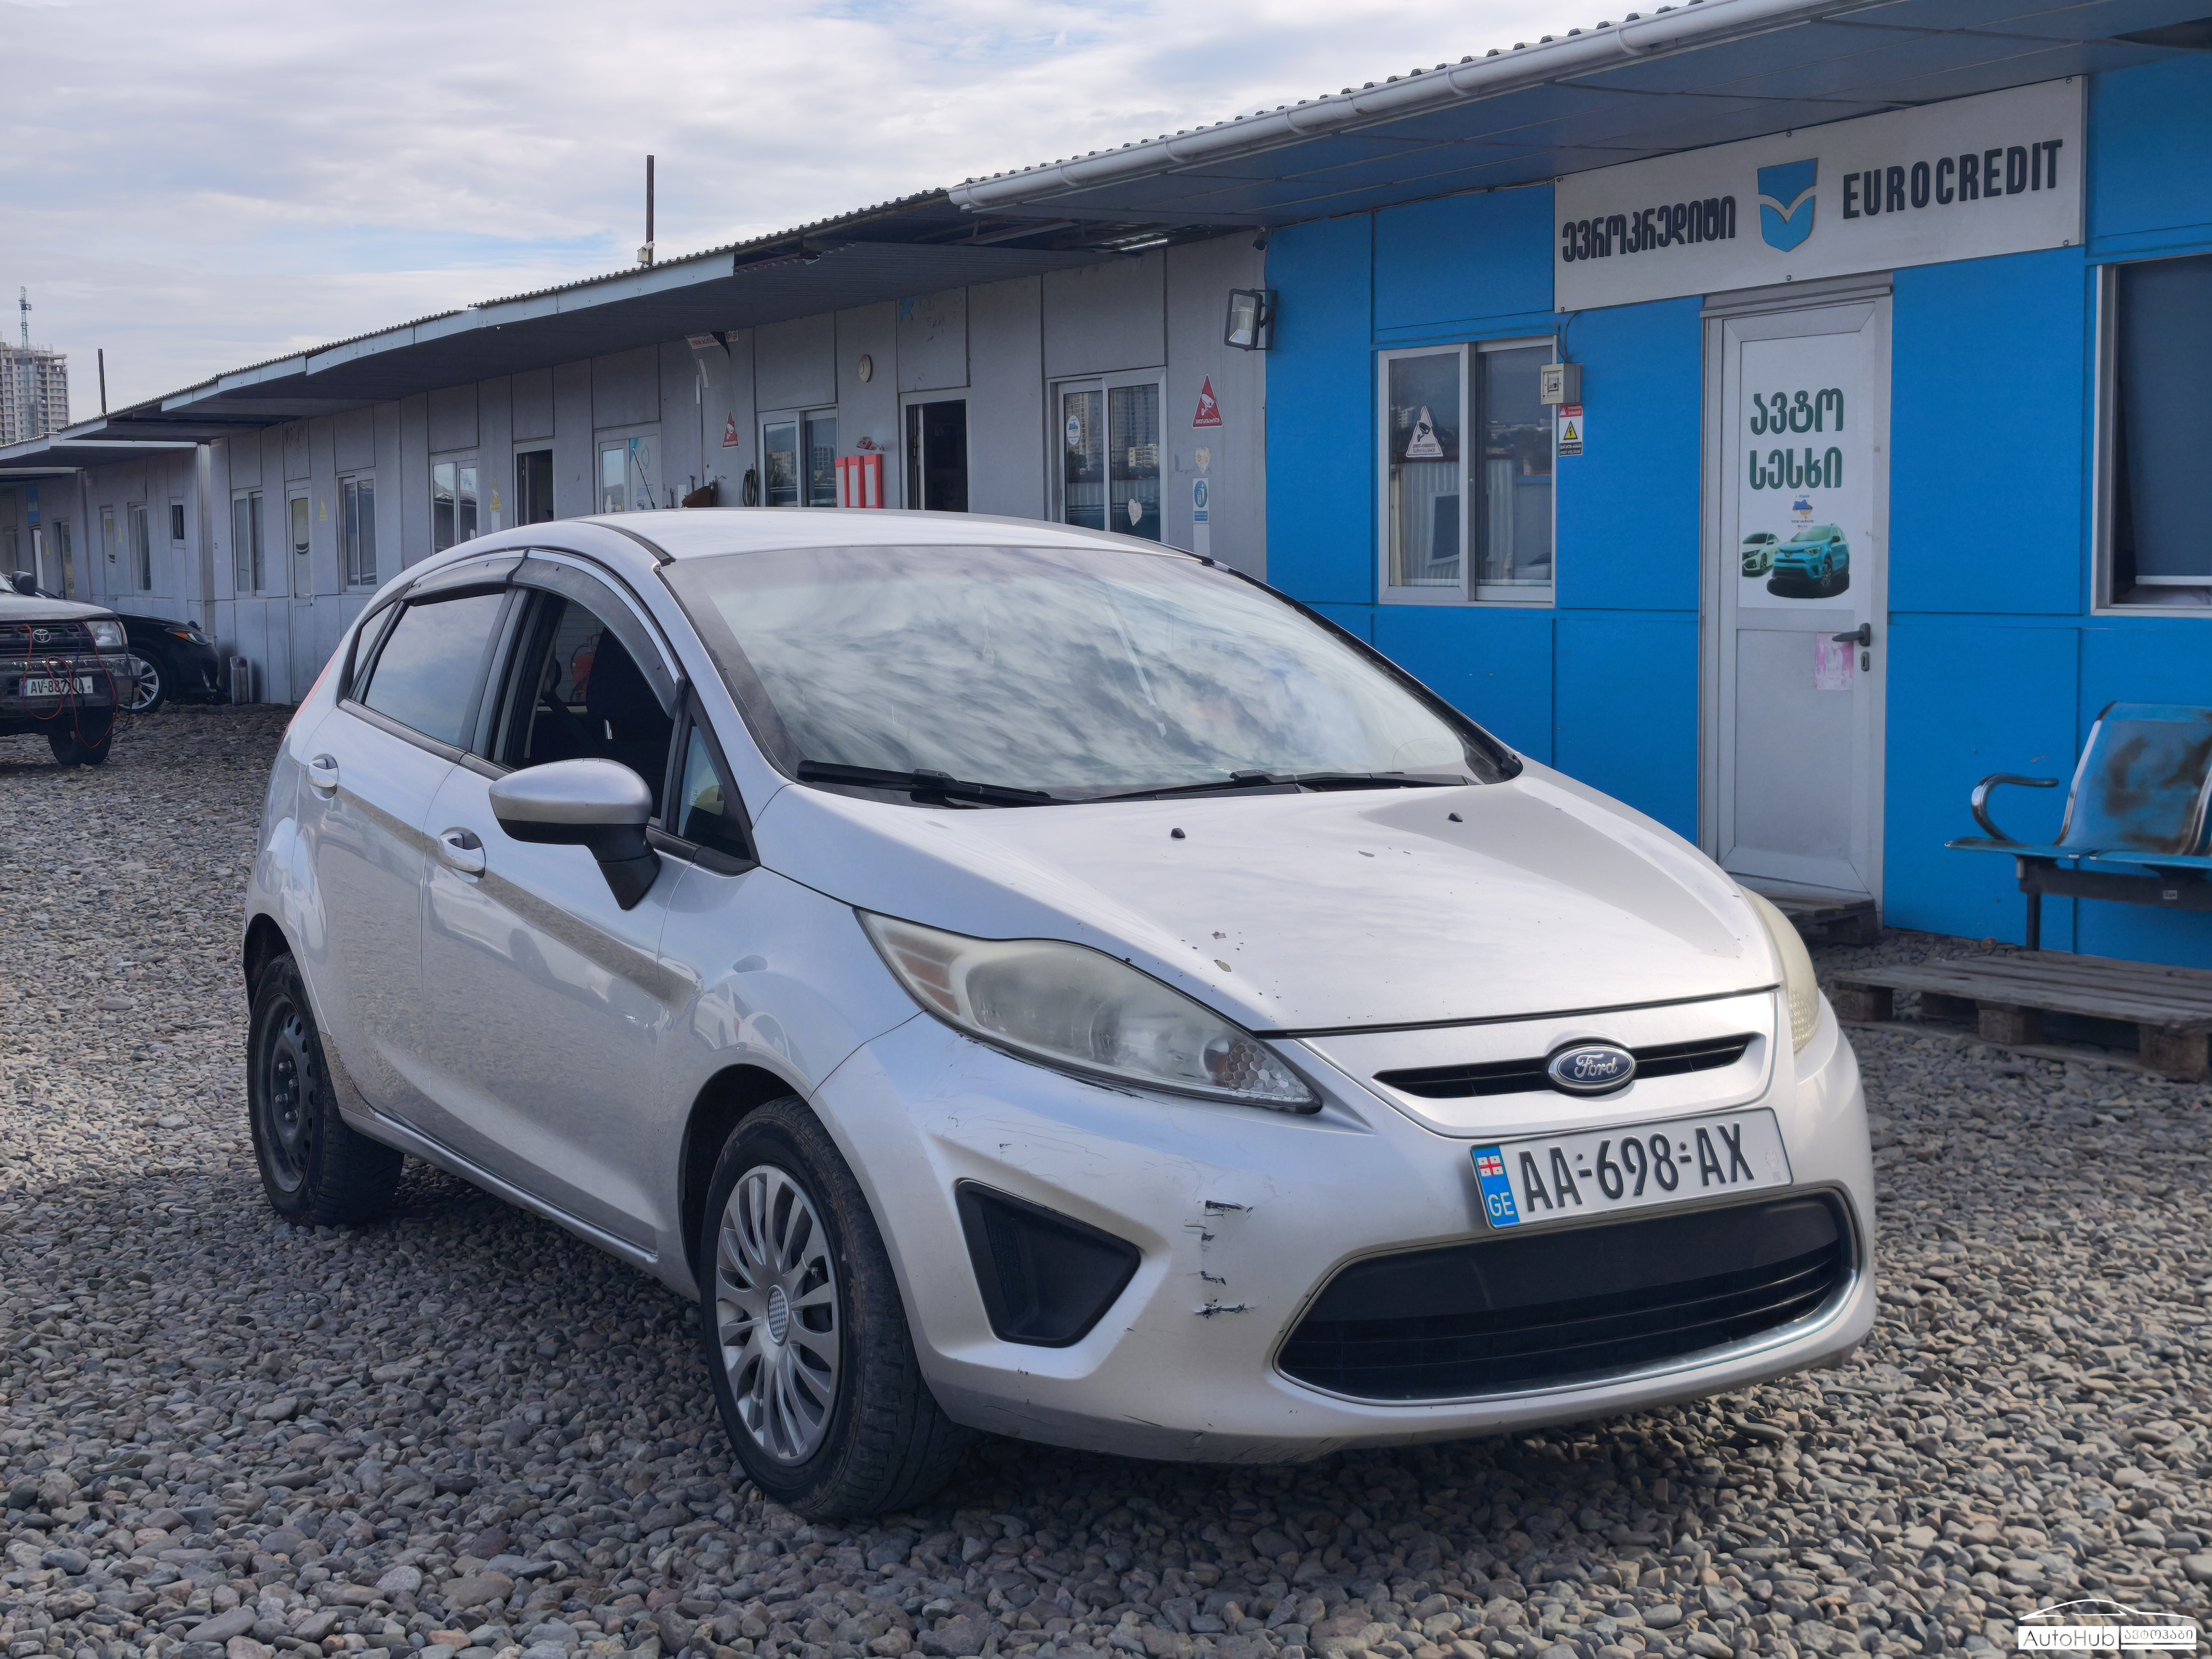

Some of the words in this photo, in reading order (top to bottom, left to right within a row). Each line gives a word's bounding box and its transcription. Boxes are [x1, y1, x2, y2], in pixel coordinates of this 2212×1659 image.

[1843, 139, 2062, 219] EUROCREDIT
[1562, 195, 1736, 262] ევროკრედიტი
[1750, 388, 1844, 435] ავტო
[1750, 447, 1842, 489] სესხი
[1574, 1054, 1617, 1078] Ford
[1519, 1121, 1754, 1212] AA-698-AX
[1488, 1192, 1514, 1217] GE
